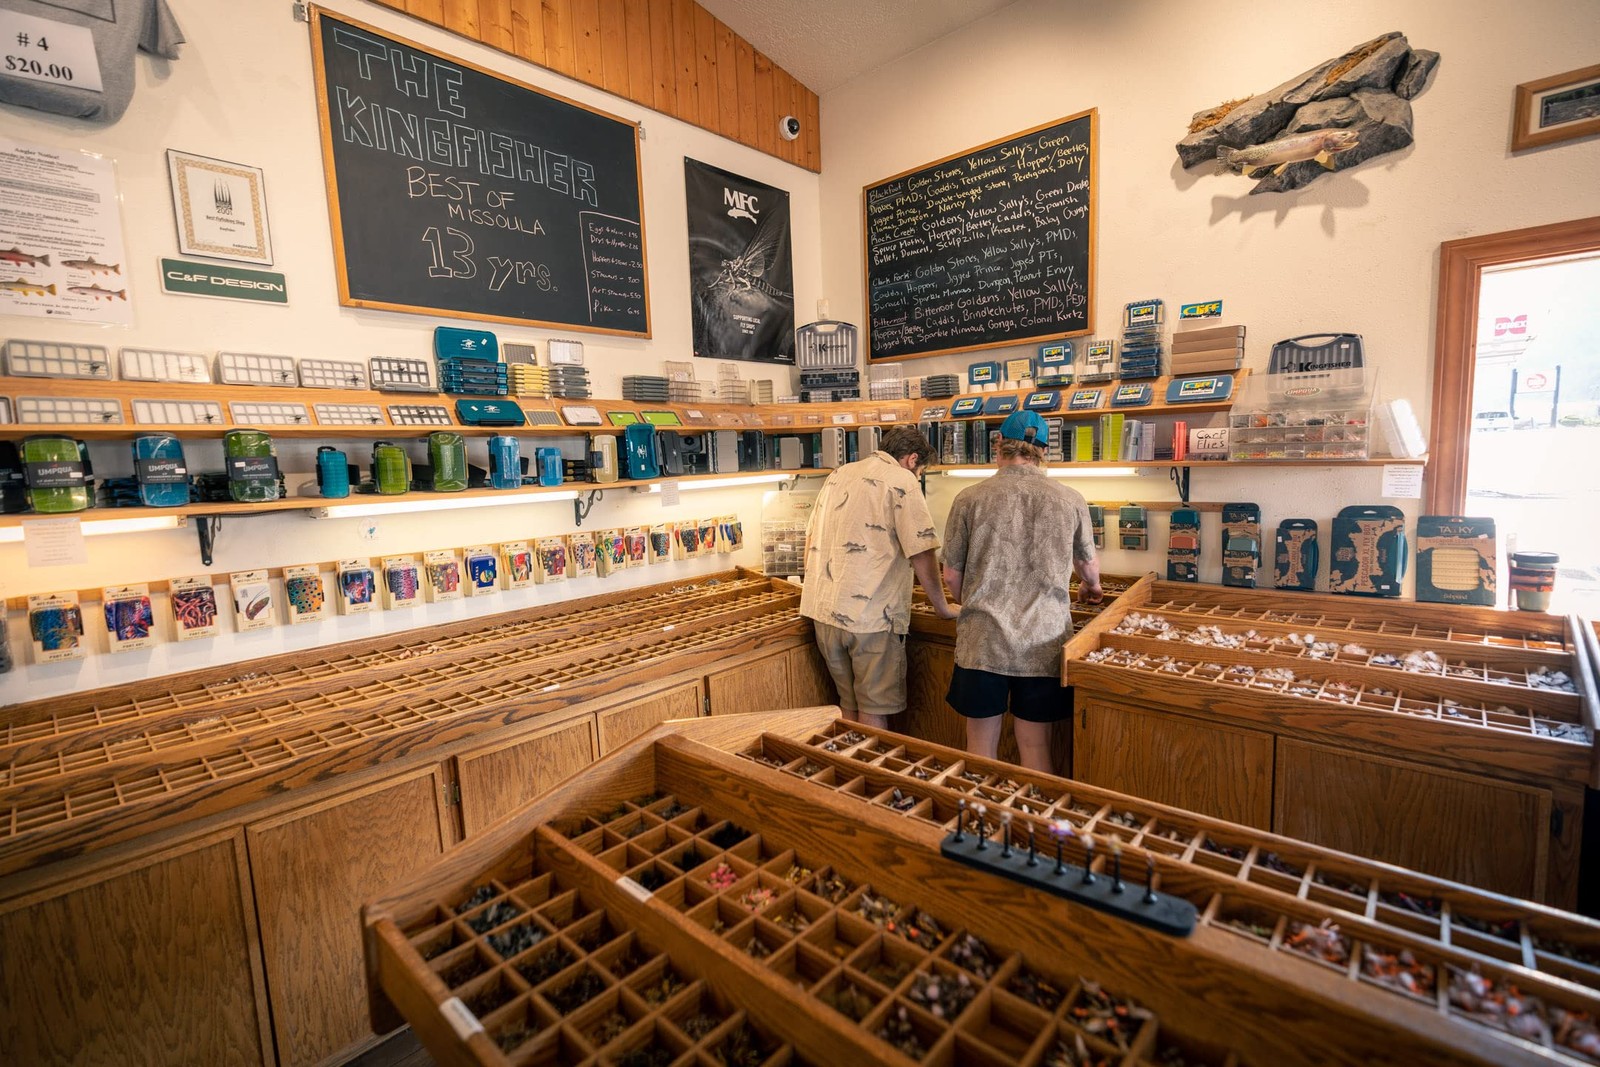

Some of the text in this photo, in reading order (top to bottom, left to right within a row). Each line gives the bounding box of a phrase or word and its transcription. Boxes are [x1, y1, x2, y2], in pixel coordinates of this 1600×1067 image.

[17, 32, 49, 52] # 4
[5, 54, 74, 82] $20.00
[333, 27, 466, 118] THE
[336, 86, 598, 208] KINGFISHER
[908, 177, 932, 191] Golden
[968, 157, 996, 172] Yellow
[1038, 135, 1070, 150] Green
[1058, 156, 1084, 173] Dolly
[406, 166, 516, 210] BEST OF
[724, 188, 760, 214] MFC
[939, 200, 966, 214] Nancy
[1034, 196, 1078, 214] Spanish
[448, 203, 546, 236] MISSOULA
[871, 232, 892, 245] Rock
[967, 208, 997, 220] Yellow
[1036, 189, 1062, 202] Green
[422, 227, 558, 292] 13 yrs.
[916, 263, 946, 278] Golden
[982, 246, 1008, 259] Yellow
[167, 272, 284, 292] C&F DESIGN
[1013, 269, 1042, 283] Peanut
[1046, 265, 1074, 284] Envy
[1008, 287, 1040, 302] Yellow
[593, 299, 613, 312] Pike
[1056, 310, 1084, 322] Kurtz
[1300, 361, 1351, 372] KINGFISHER
[38, 466, 73, 476] UMPQUA
[148, 464, 178, 472] UMPQUA
[1361, 560, 1369, 586] PESCADOR
